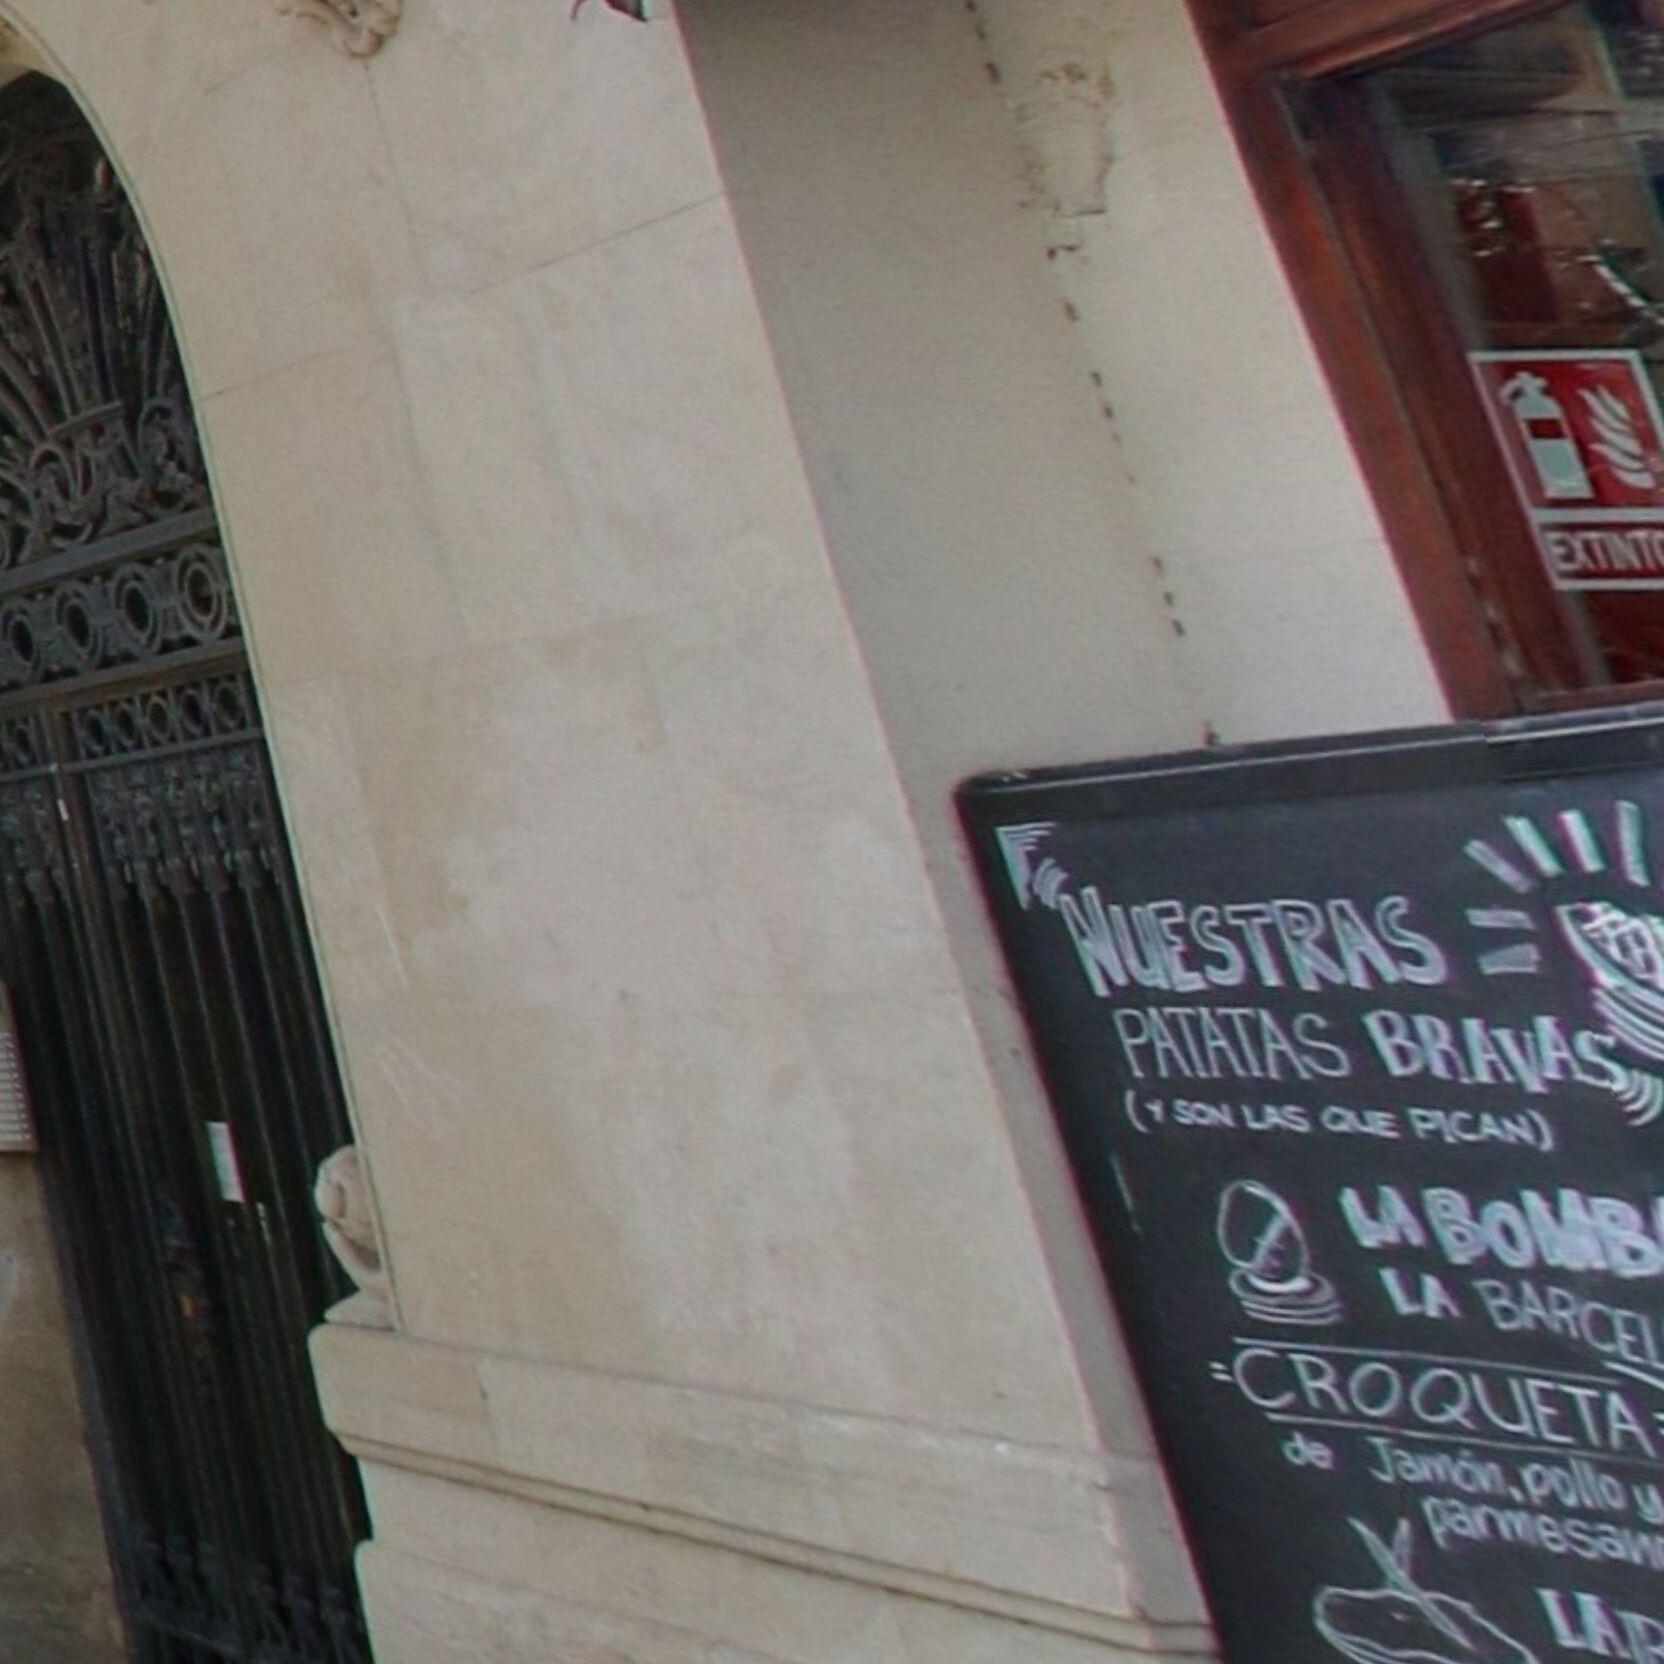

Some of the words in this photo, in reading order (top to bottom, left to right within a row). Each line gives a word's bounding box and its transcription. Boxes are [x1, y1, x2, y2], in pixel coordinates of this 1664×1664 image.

[1059, 885, 1448, 998] NUESTRAS
[1113, 1007, 1351, 1080] PATATAS
[1363, 1008, 1628, 1094] BRAVAS
[1173, 1099, 1234, 1128] SON
[1244, 1103, 1310, 1133] LAS
[1321, 1105, 1401, 1139] QUE
[1340, 1185, 1425, 1248] LA
[1379, 1266, 1463, 1318] LA
[1281, 1430, 1336, 1471] de
